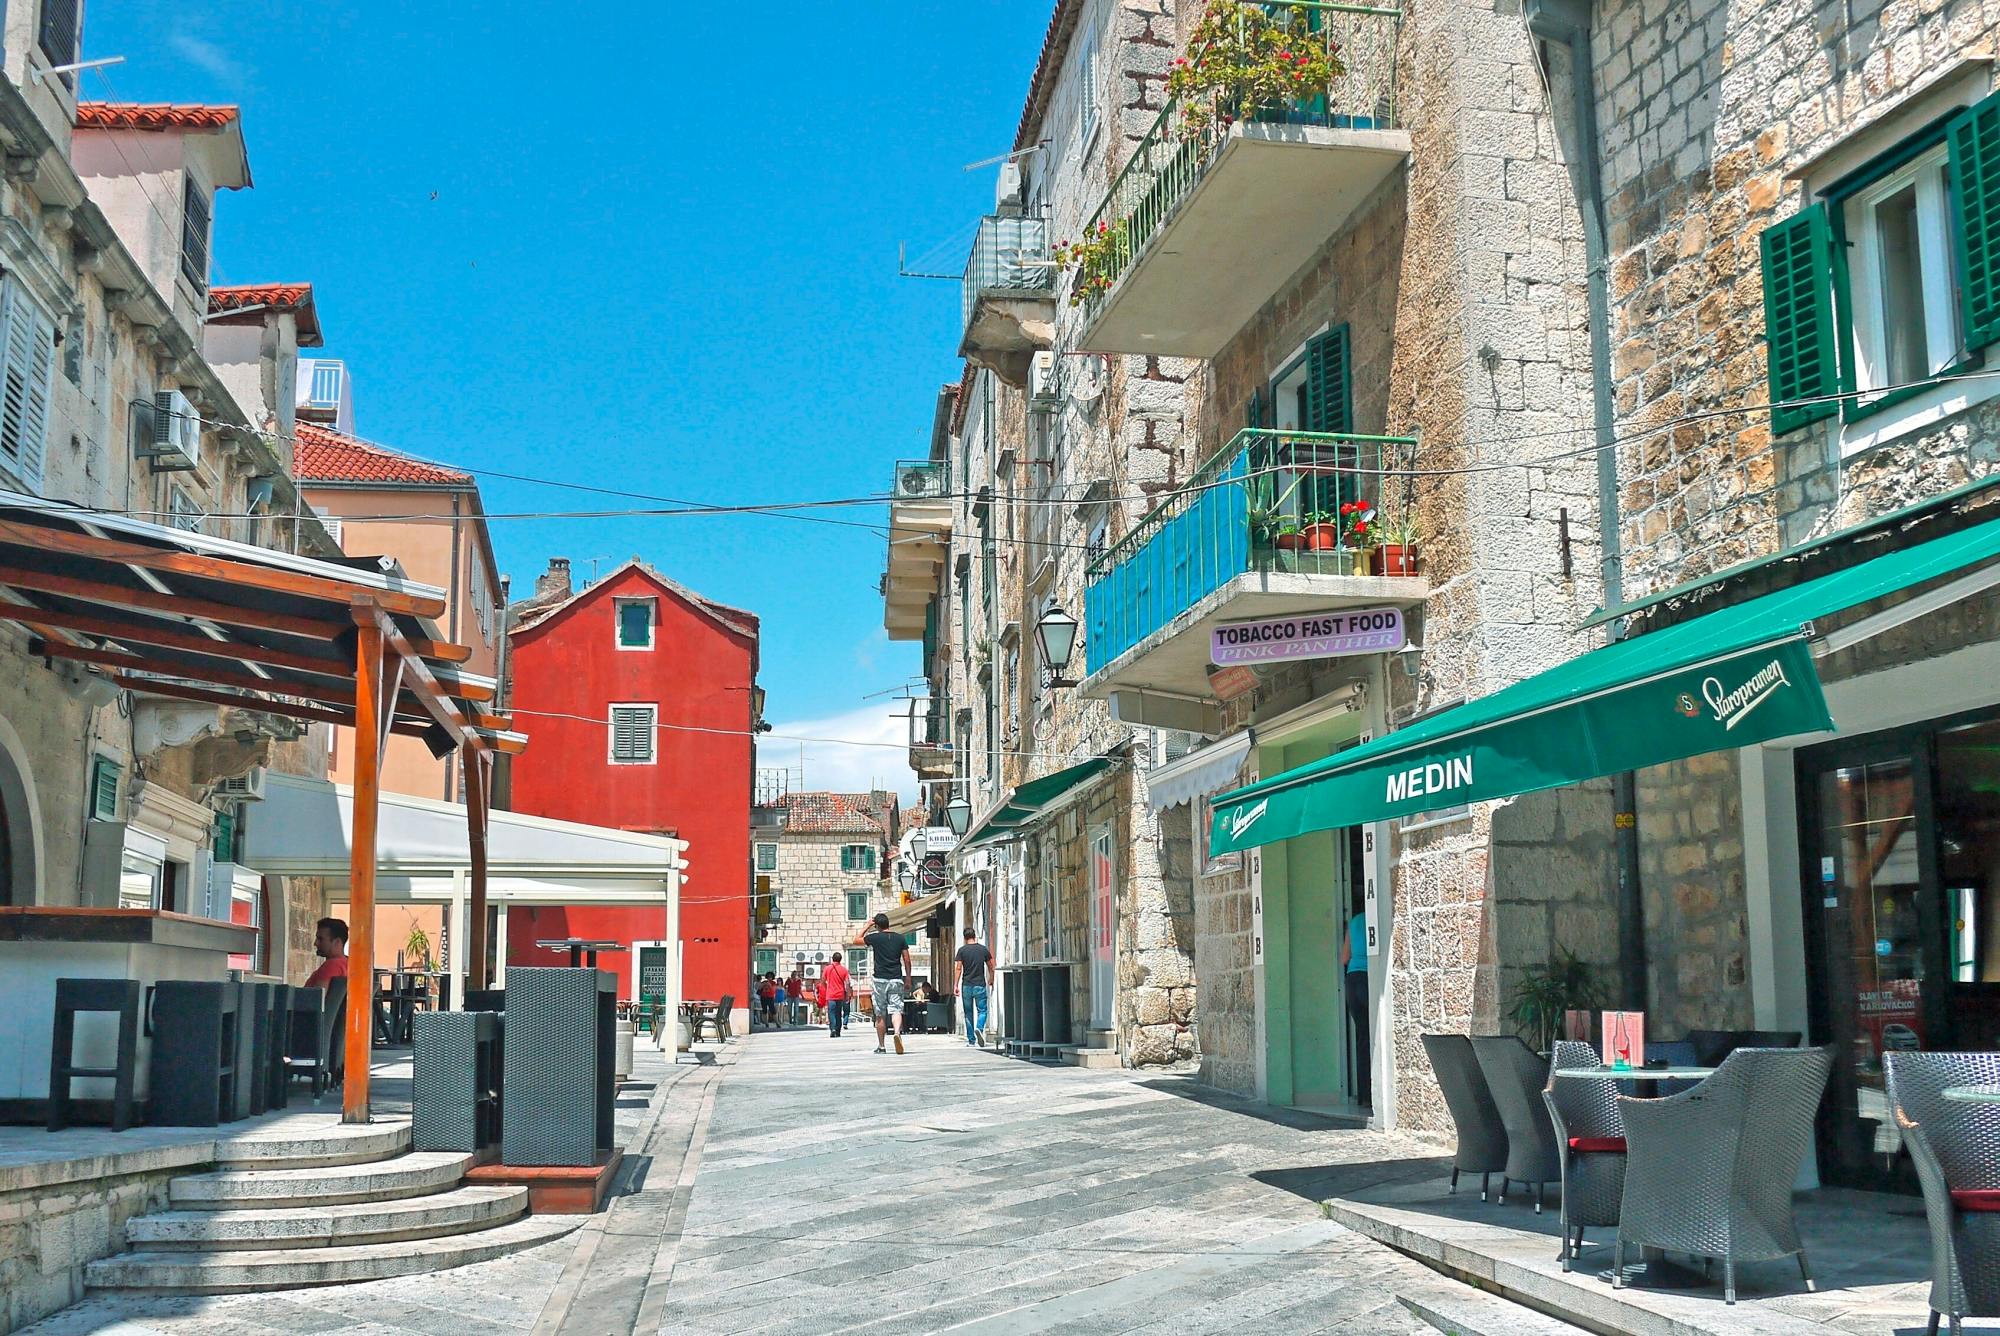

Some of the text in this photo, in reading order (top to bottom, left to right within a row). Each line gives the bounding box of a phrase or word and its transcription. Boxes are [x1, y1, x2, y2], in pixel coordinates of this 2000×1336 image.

[1216, 612, 1396, 645] TOBACCO FAST FOOD
[1221, 633, 1393, 661] PINK PANTHER
[1702, 659, 1791, 730] Staropramen
[1386, 755, 1473, 803] MEDIN
